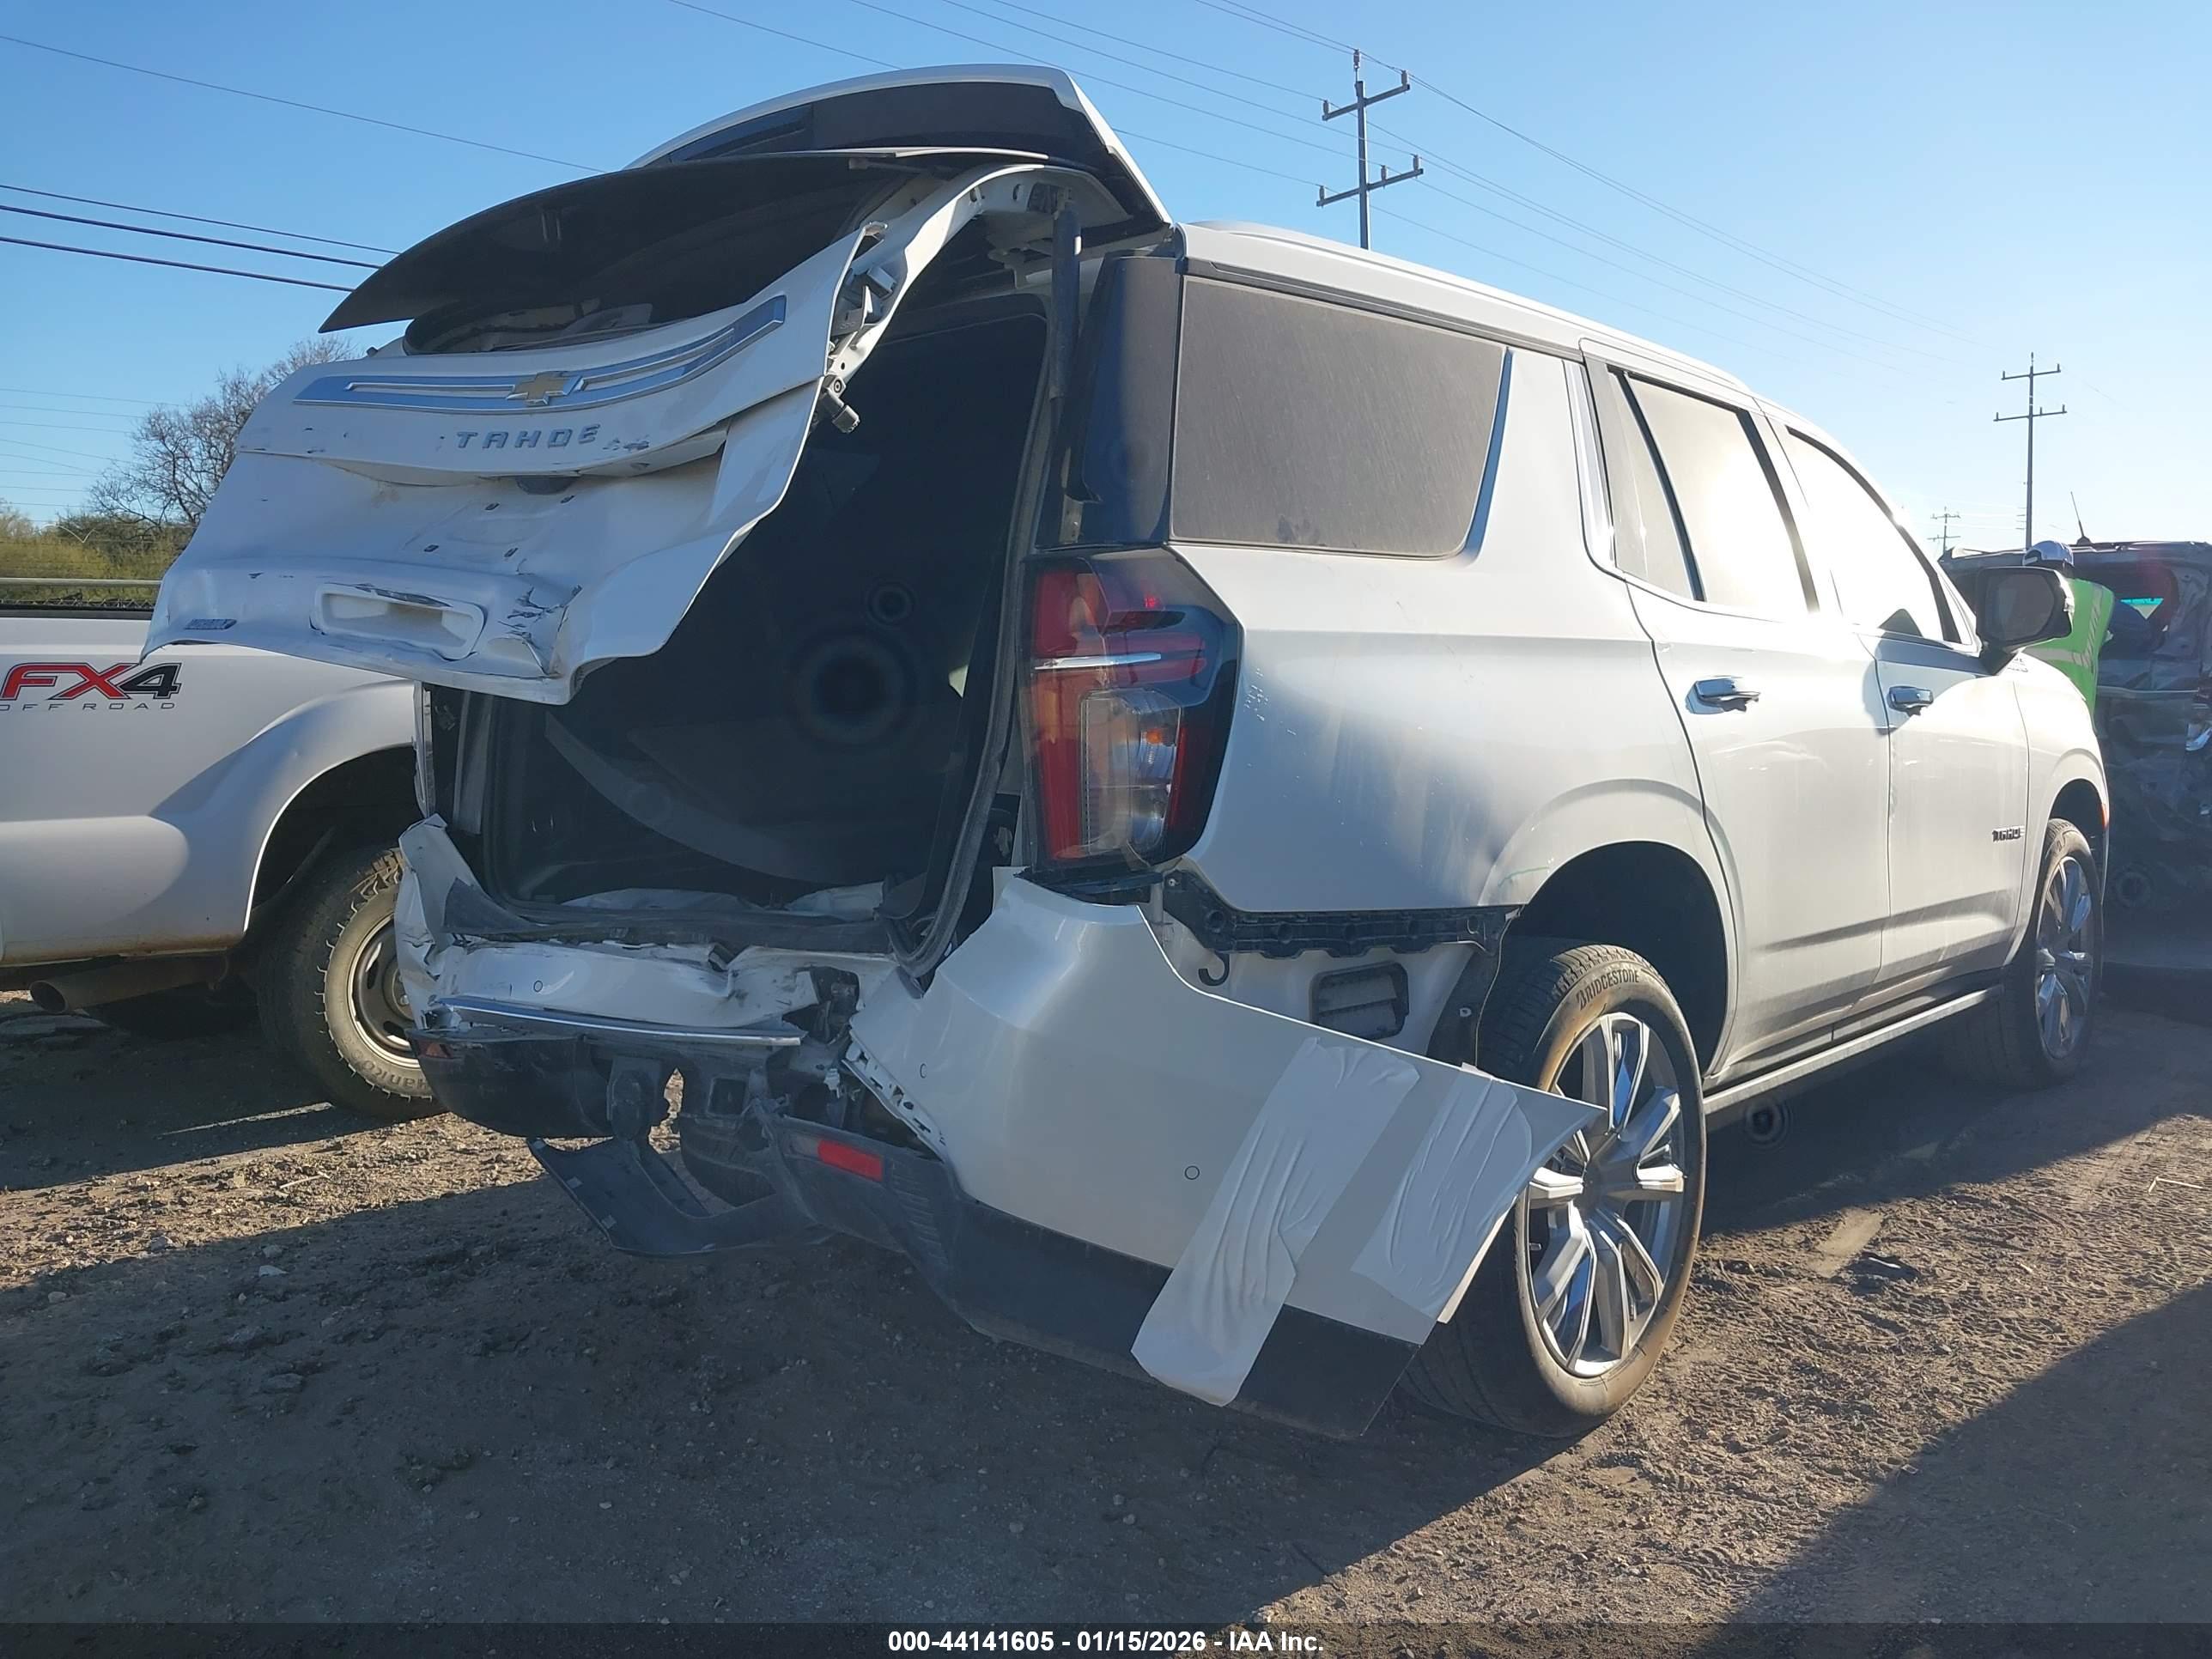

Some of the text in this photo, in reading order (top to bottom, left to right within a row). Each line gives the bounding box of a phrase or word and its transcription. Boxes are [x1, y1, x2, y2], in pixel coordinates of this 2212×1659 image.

[455, 423, 601, 450] TAHOE
[0, 661, 183, 701] FX4
[82, 702, 176, 711] ROAD
[1576, 969, 1639, 1011] BRIDGESTONE
